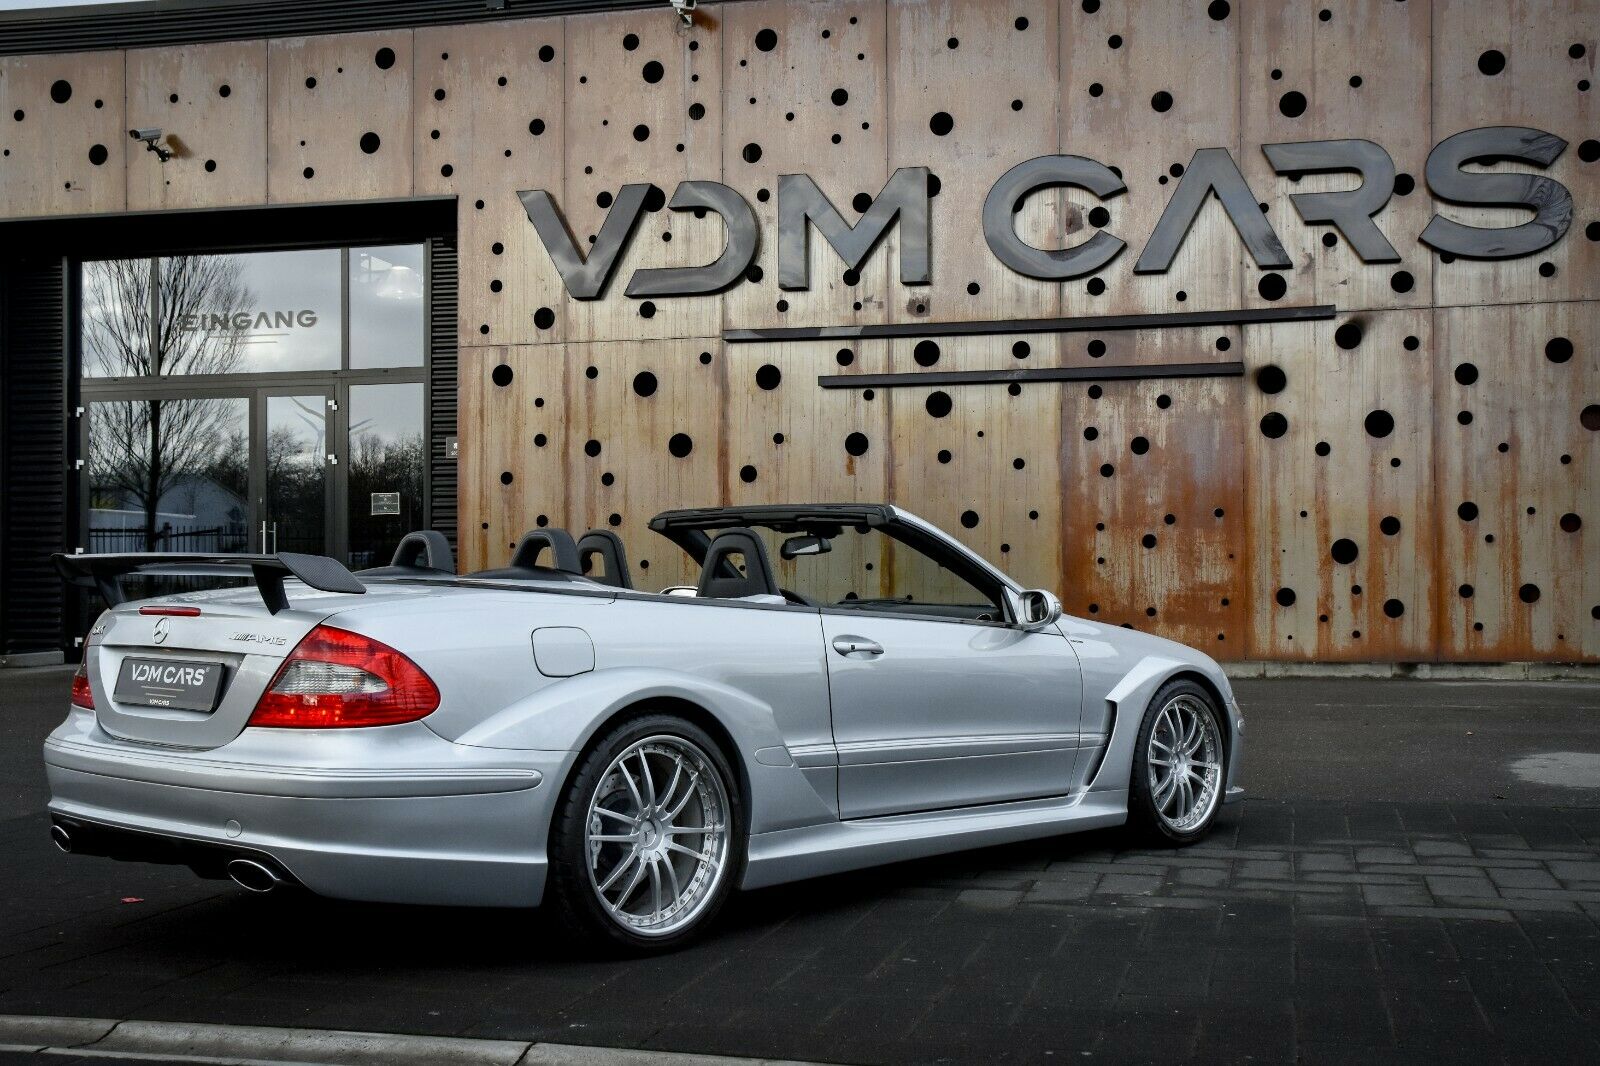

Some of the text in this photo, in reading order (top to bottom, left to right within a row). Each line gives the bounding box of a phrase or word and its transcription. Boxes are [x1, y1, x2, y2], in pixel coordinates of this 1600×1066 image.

[516, 125, 1574, 301] VDM CARS
[181, 309, 318, 332] EINGANG
[132, 663, 163, 683] VDM
